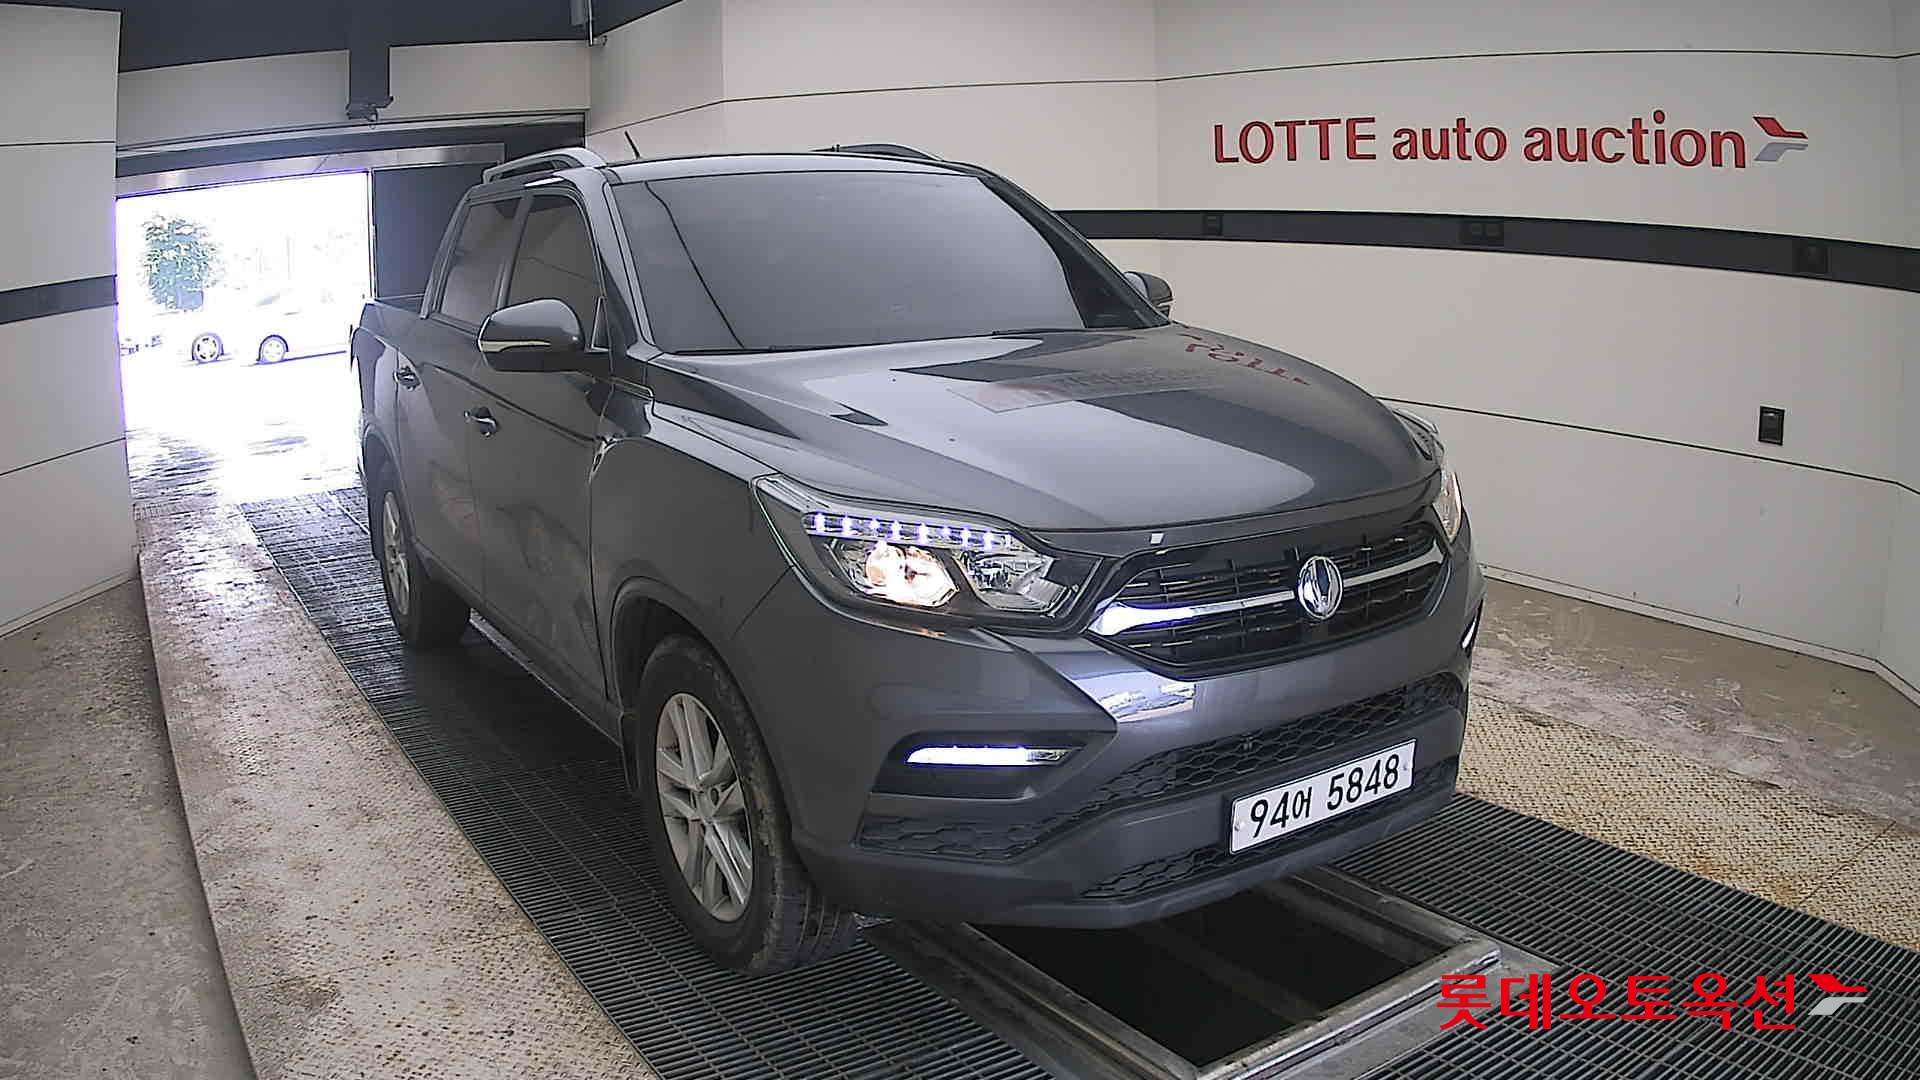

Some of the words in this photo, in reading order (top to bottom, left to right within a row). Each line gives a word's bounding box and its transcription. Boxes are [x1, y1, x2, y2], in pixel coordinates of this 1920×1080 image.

[1213, 116, 1377, 164] LOTTE
[1392, 117, 1508, 161] auto
[1523, 110, 1746, 169] auction
[1250, 786, 1313, 838] 94어
[1327, 754, 1400, 811] 5848
